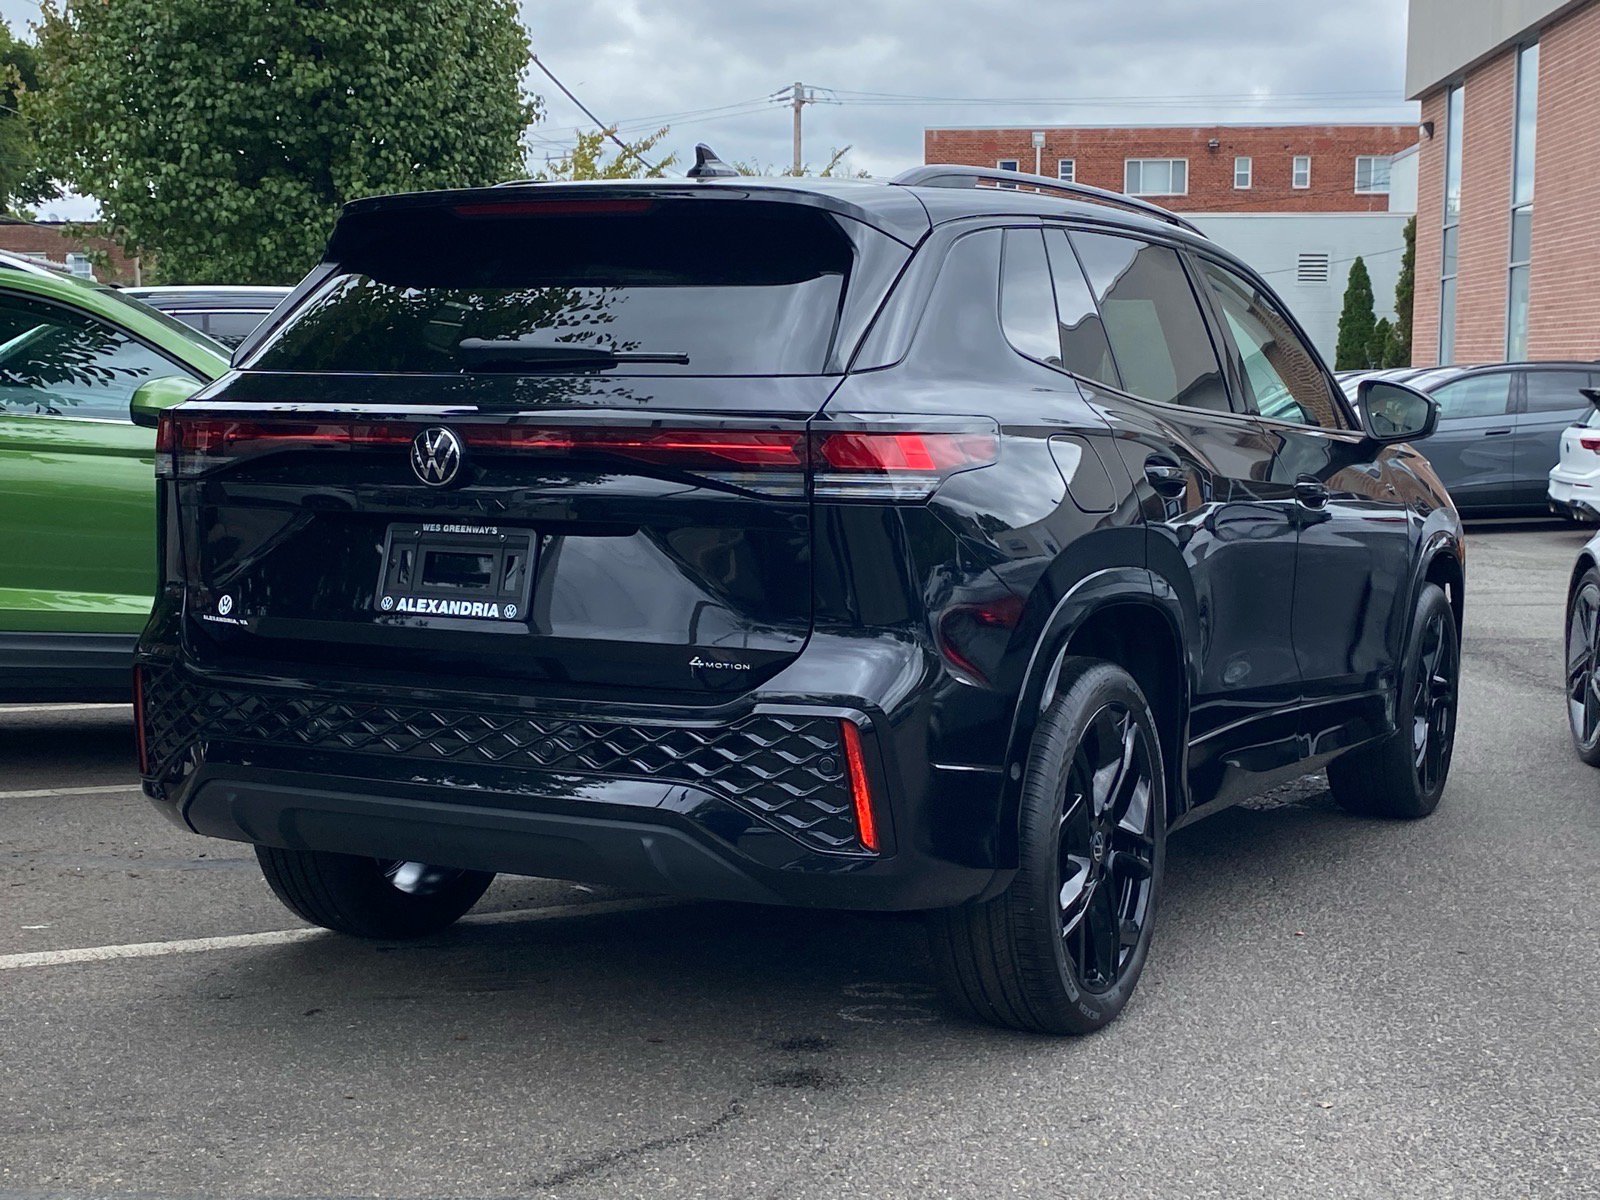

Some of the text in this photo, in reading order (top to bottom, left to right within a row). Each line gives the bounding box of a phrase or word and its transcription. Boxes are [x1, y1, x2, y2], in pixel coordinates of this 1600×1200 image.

[422, 523, 498, 535] WES GREENWAY'S
[396, 597, 499, 618] ALEXANDRIA
[689, 656, 750, 670] 4MOTION
